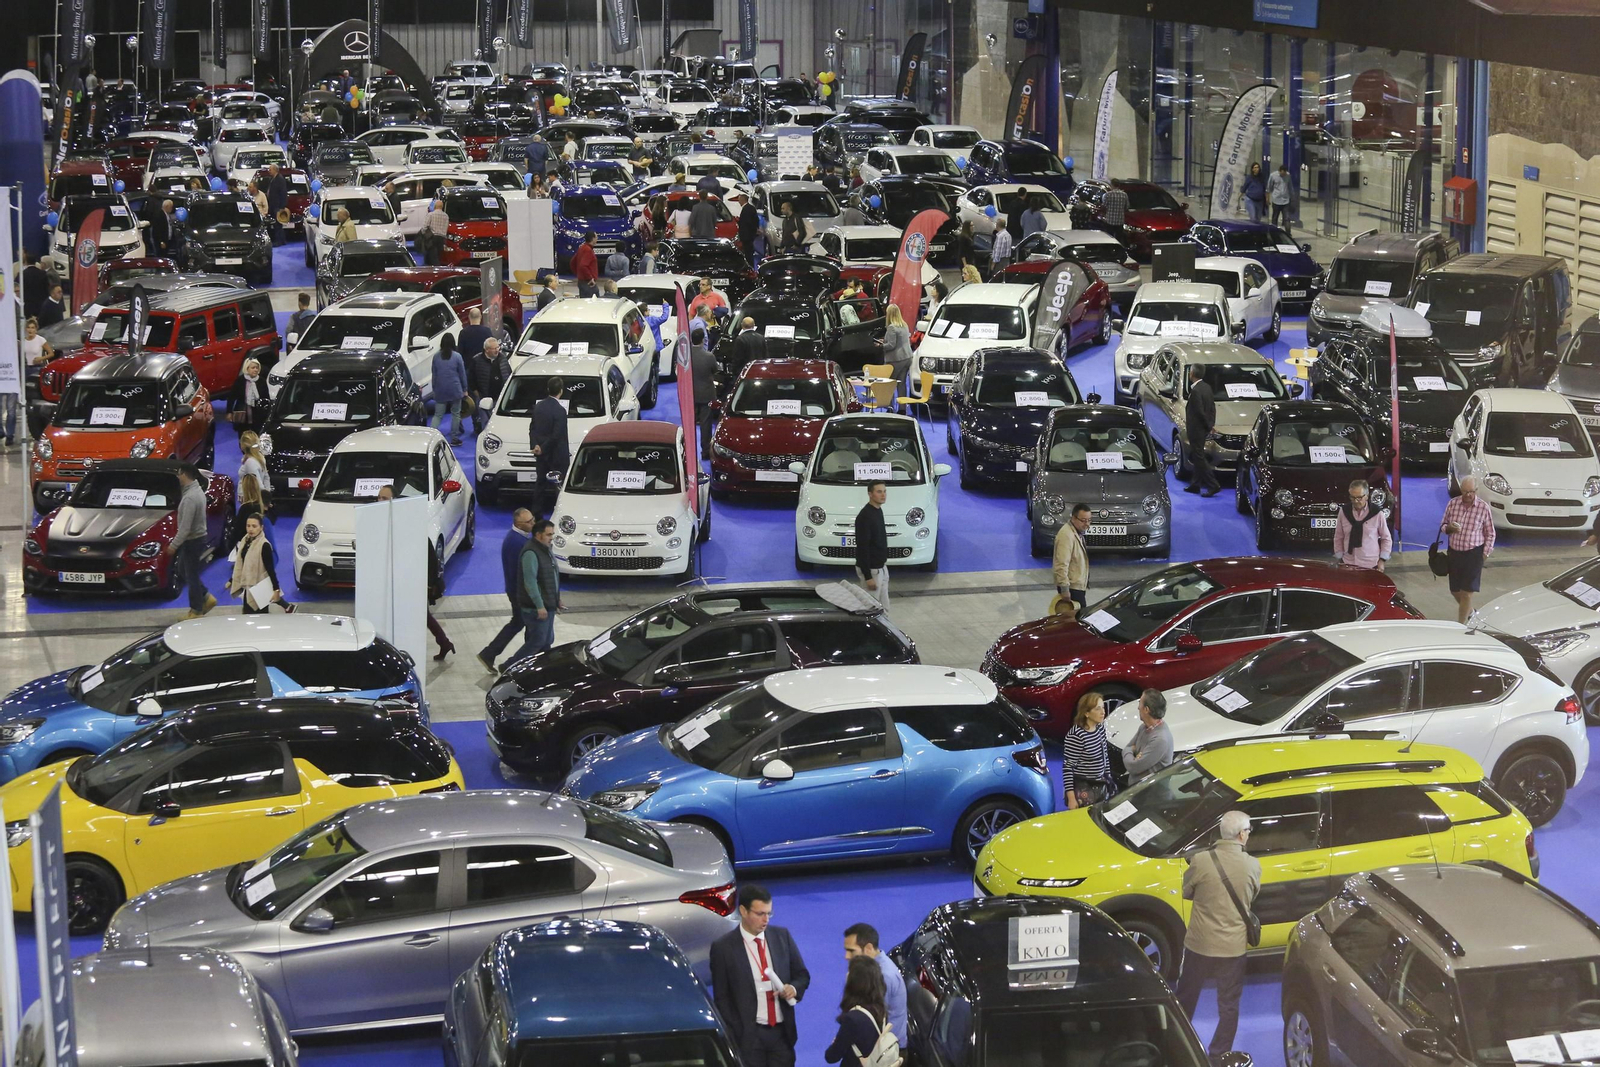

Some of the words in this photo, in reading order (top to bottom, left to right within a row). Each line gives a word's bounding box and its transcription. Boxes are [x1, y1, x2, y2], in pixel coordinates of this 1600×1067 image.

[71, 11, 82, 60] Mercedes-Benz
[153, 11, 164, 60] Mercedes-Benz
[1228, 132, 1245, 165] Garum
[1238, 102, 1256, 132] Motor
[1046, 270, 1074, 322] Jeep
[132, 296, 143, 342] Jeep
[1316, 519, 1337, 527] 3903
[1086, 526, 1107, 534] 4339
[1109, 526, 1125, 534] KNX
[847, 537, 857, 546] 38
[597, 548, 618, 556] 3800
[620, 548, 637, 556] KNY
[64, 573, 85, 581] 4586
[87, 574, 103, 582] JYP
[1024, 926, 1063, 935] OFERTA
[1023, 945, 1050, 960] KM
